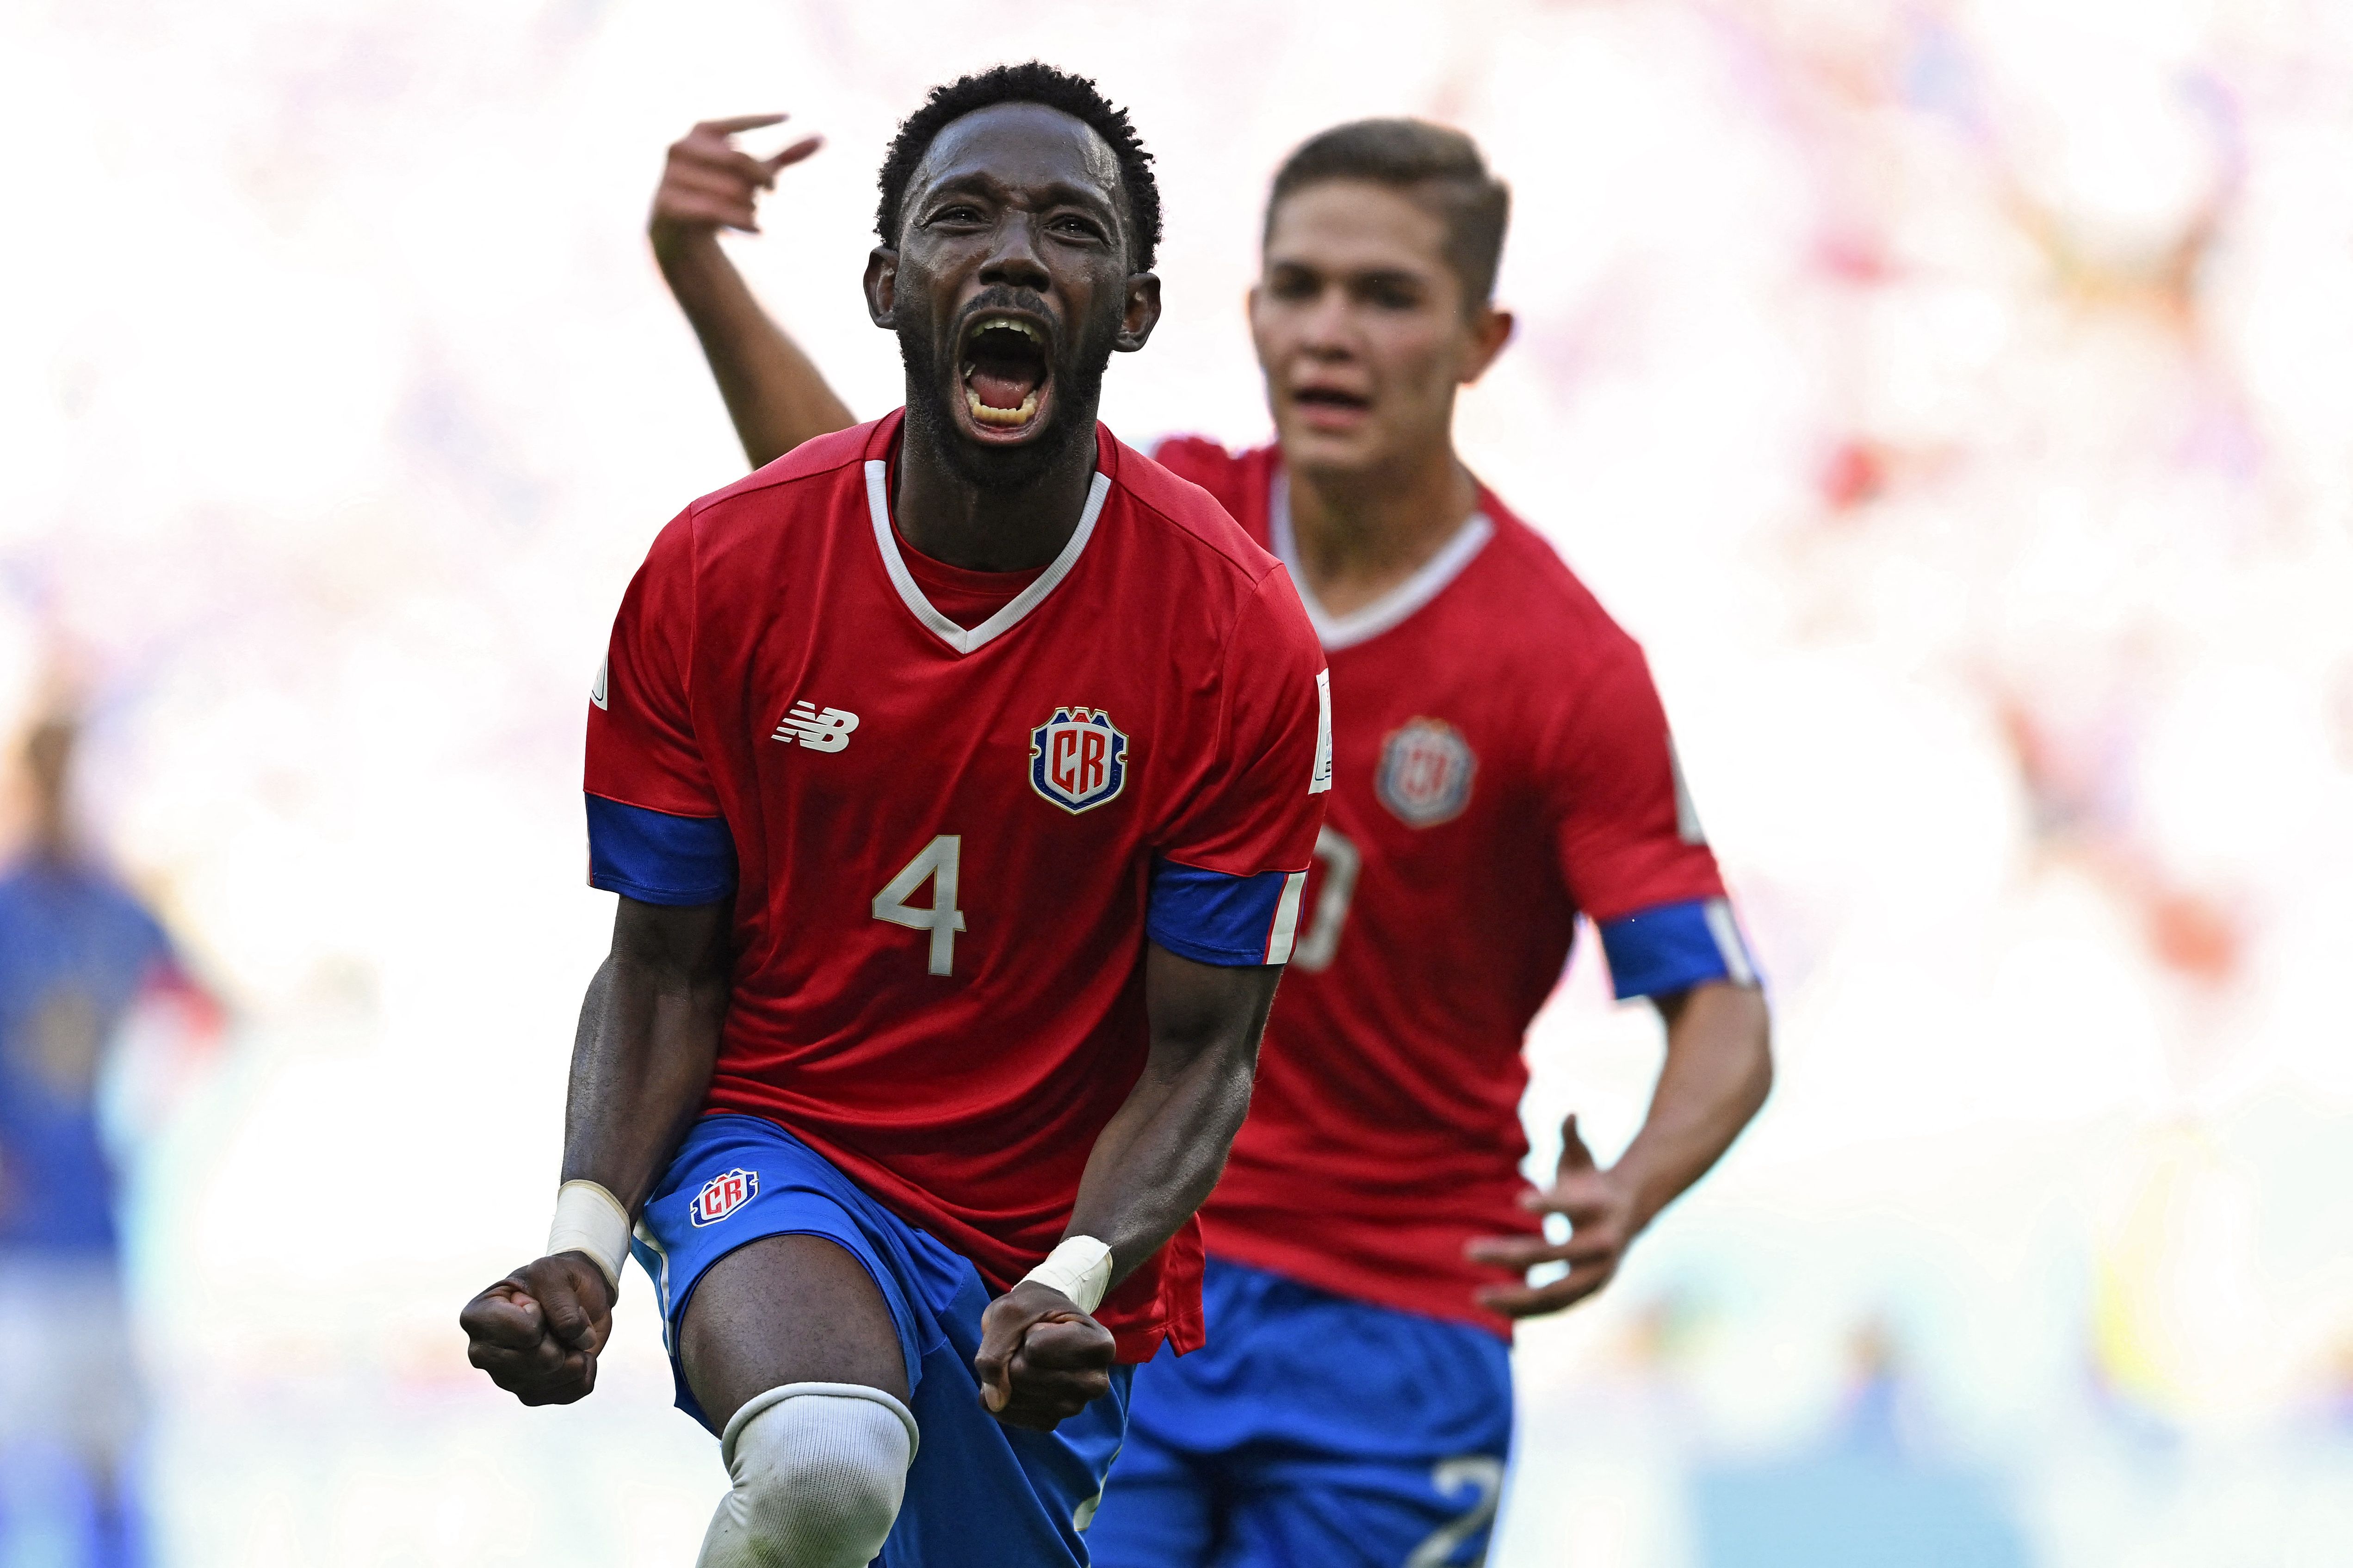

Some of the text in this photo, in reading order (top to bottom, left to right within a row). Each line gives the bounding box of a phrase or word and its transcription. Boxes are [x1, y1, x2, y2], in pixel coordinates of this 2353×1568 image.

[1052, 729, 1106, 795] CR
[872, 835, 967, 976] 4
[705, 1179, 742, 1216] CR
